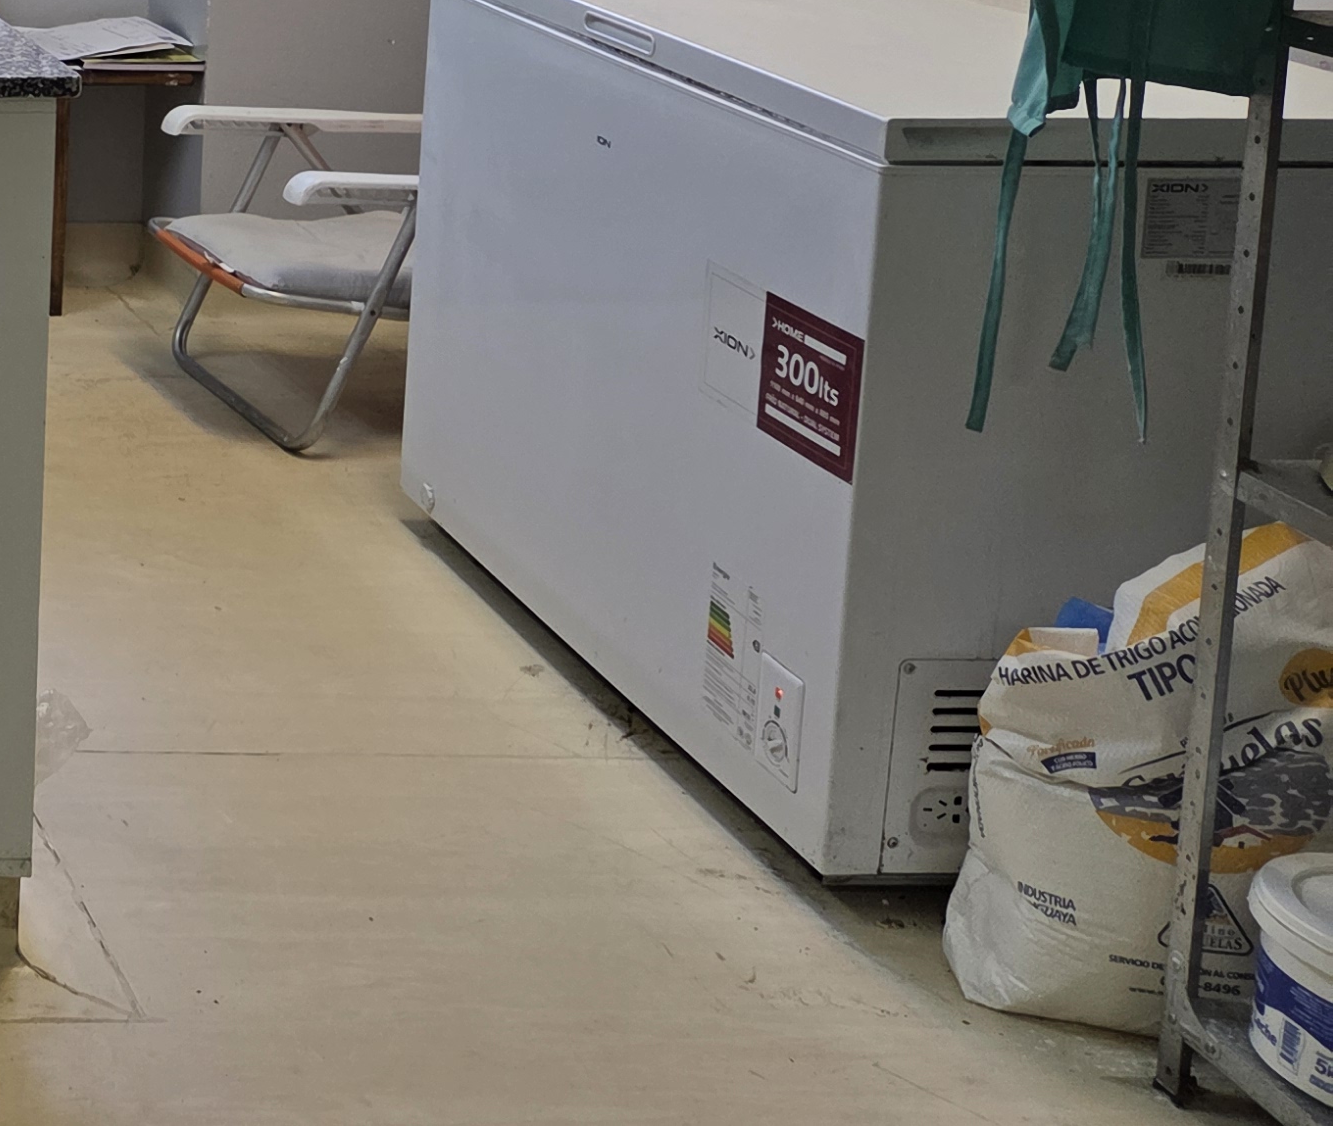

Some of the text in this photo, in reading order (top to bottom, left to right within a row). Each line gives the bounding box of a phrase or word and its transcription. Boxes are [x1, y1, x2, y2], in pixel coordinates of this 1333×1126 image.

[1151, 183, 1200, 194] XION
[713, 326, 750, 358] XION
[774, 344, 840, 407] 300lts
[998, 658, 1073, 687] HARINA
[1073, 655, 1106, 679] DE
[1100, 634, 1166, 671] TRIGO
[1017, 880, 1077, 912] INDUSTRIA
